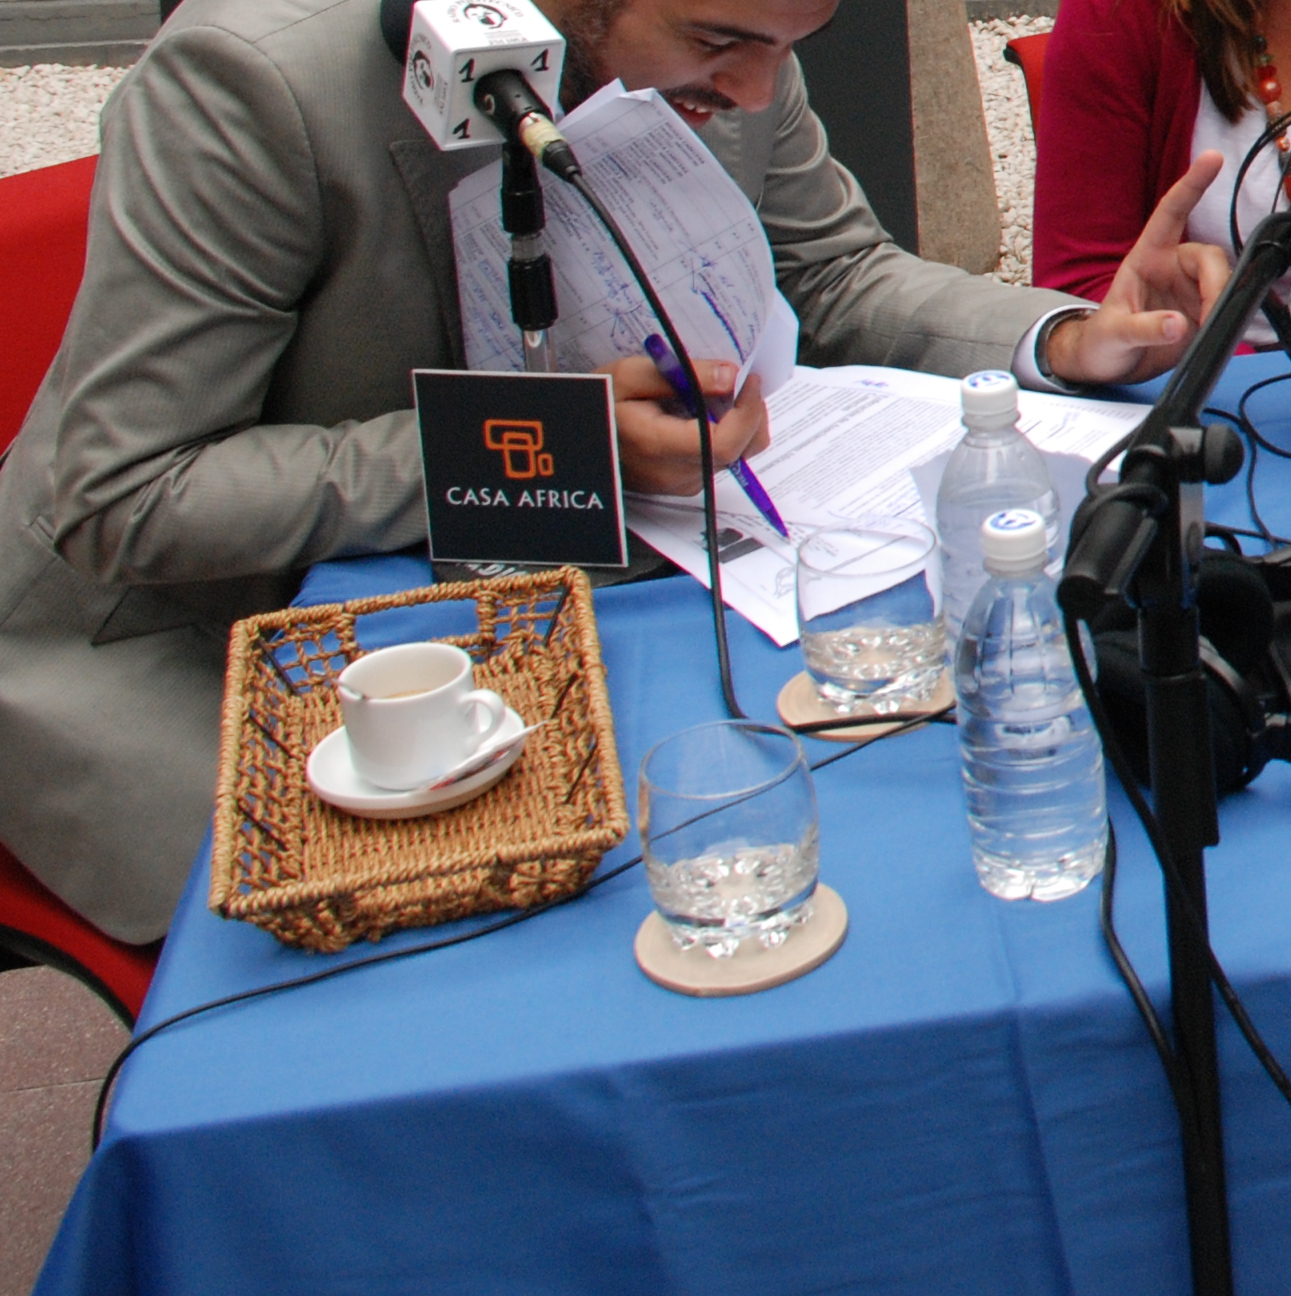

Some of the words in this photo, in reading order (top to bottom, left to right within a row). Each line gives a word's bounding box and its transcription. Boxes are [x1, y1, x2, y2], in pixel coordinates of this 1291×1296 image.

[458, 58, 476, 84] 1
[530, 49, 551, 72] 1
[451, 118, 472, 140] 1
[447, 487, 509, 507] CASA
[518, 489, 605, 510] AFRICA
